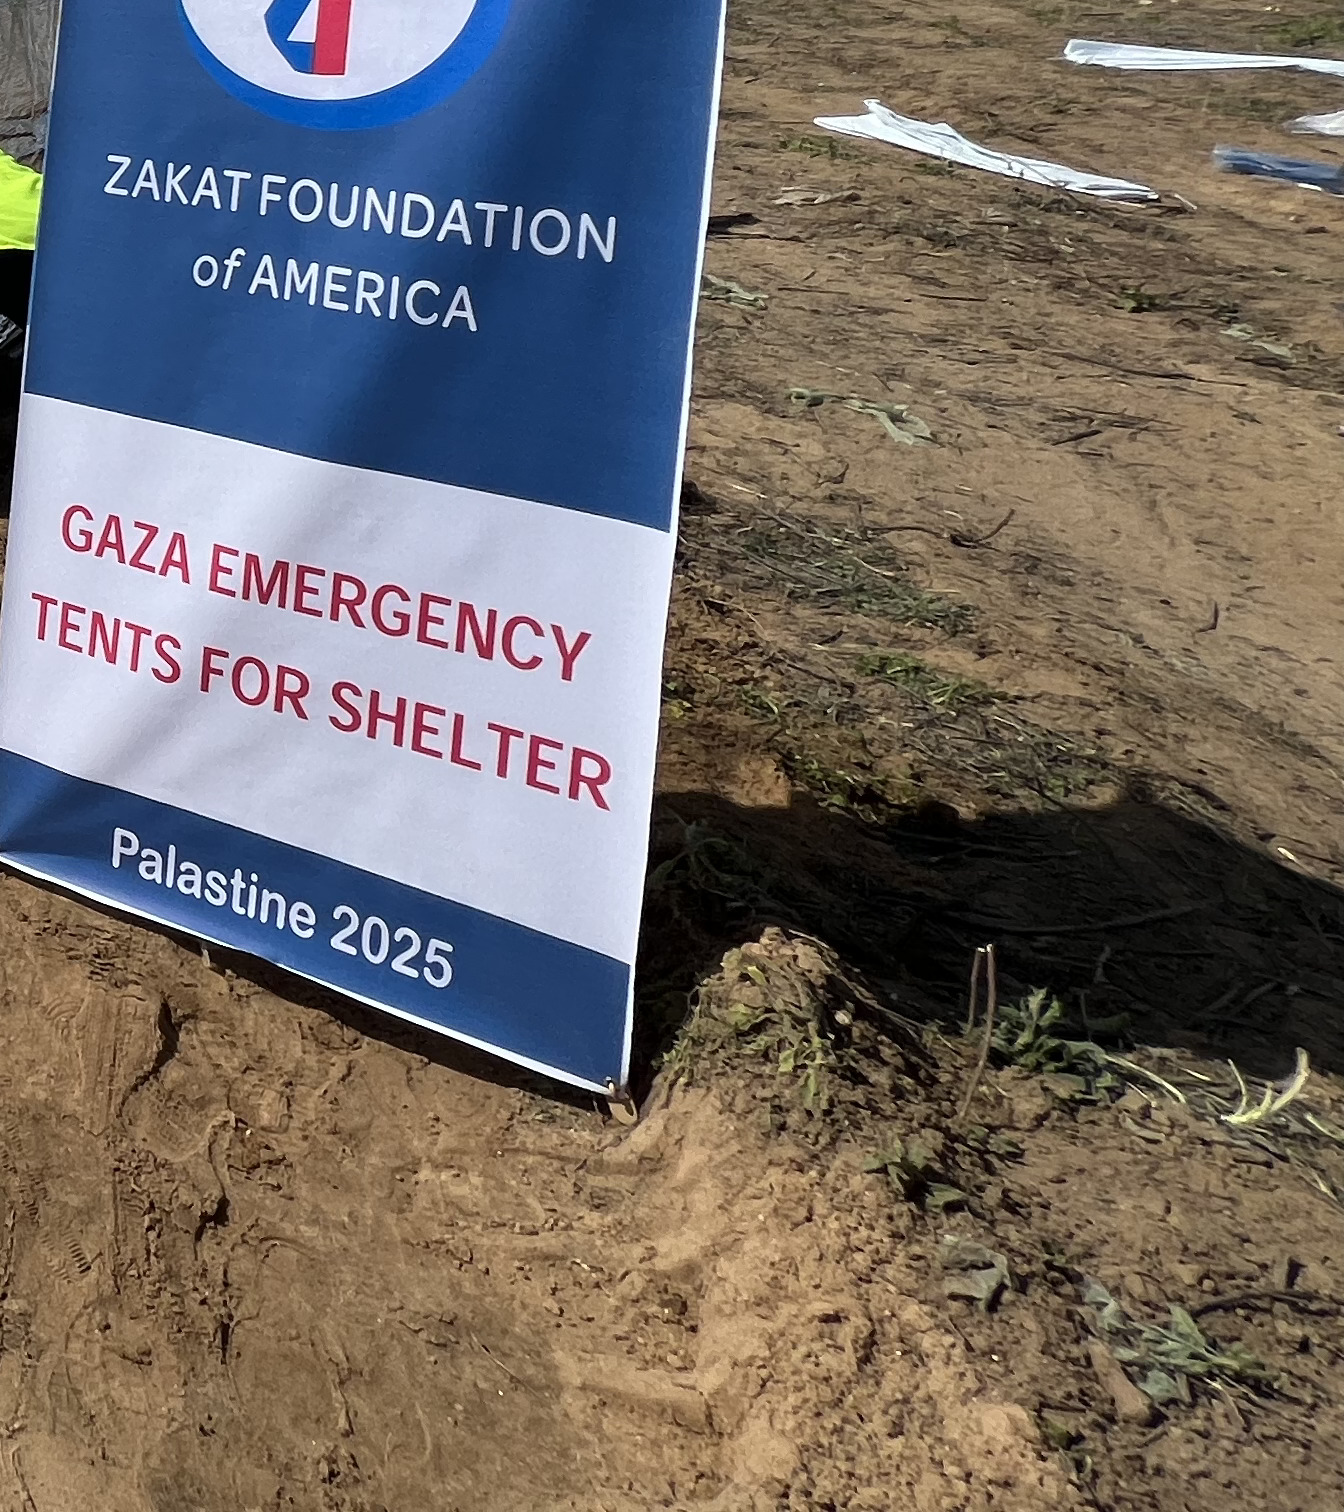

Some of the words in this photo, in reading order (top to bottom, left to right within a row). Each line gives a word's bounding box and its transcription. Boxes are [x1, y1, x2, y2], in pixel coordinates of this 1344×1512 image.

[104, 154, 251, 213] ZAKAT
[258, 174, 618, 264] FOUNDATION
[192, 248, 244, 290] of
[248, 252, 479, 332] AMERICA
[60, 504, 192, 584] GAZA
[208, 544, 592, 682] EMERGENCY
[31, 592, 183, 685] TENTS
[199, 647, 310, 720] FOR
[328, 681, 612, 812] SHELTER
[111, 827, 315, 939] Palastine
[330, 904, 455, 988] 2025
